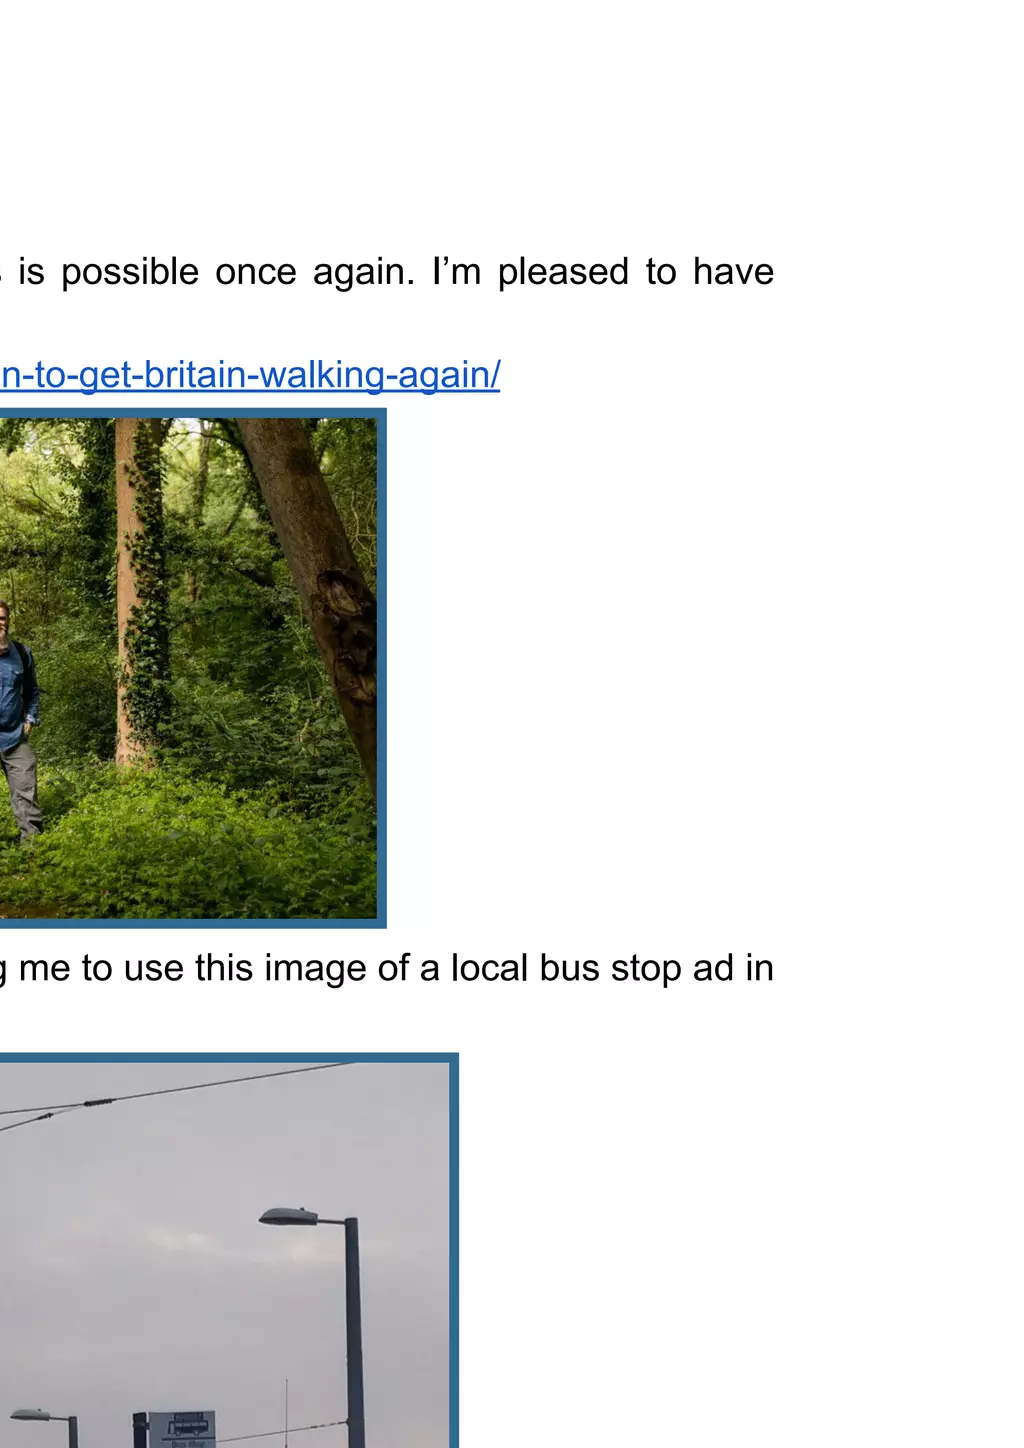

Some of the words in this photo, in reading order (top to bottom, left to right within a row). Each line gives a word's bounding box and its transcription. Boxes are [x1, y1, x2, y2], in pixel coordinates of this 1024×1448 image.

[20, 257, 44, 285] is
[63, 256, 198, 292] possible
[216, 264, 296, 285] once
[314, 257, 413, 292] again.
[500, 256, 627, 292] pleased
[646, 258, 676, 285] to
[695, 257, 773, 285] have
[21, 960, 70, 981] me
[82, 954, 112, 981] to
[126, 960, 183, 981] use
[195, 953, 252, 981] this
[266, 953, 366, 988] image
[379, 953, 411, 981] of
[421, 960, 439, 981] a
[453, 953, 526, 981] local
[542, 953, 599, 981] bus
[612, 954, 681, 988] stop
[694, 953, 732, 981] ad
[748, 953, 772, 981] in
